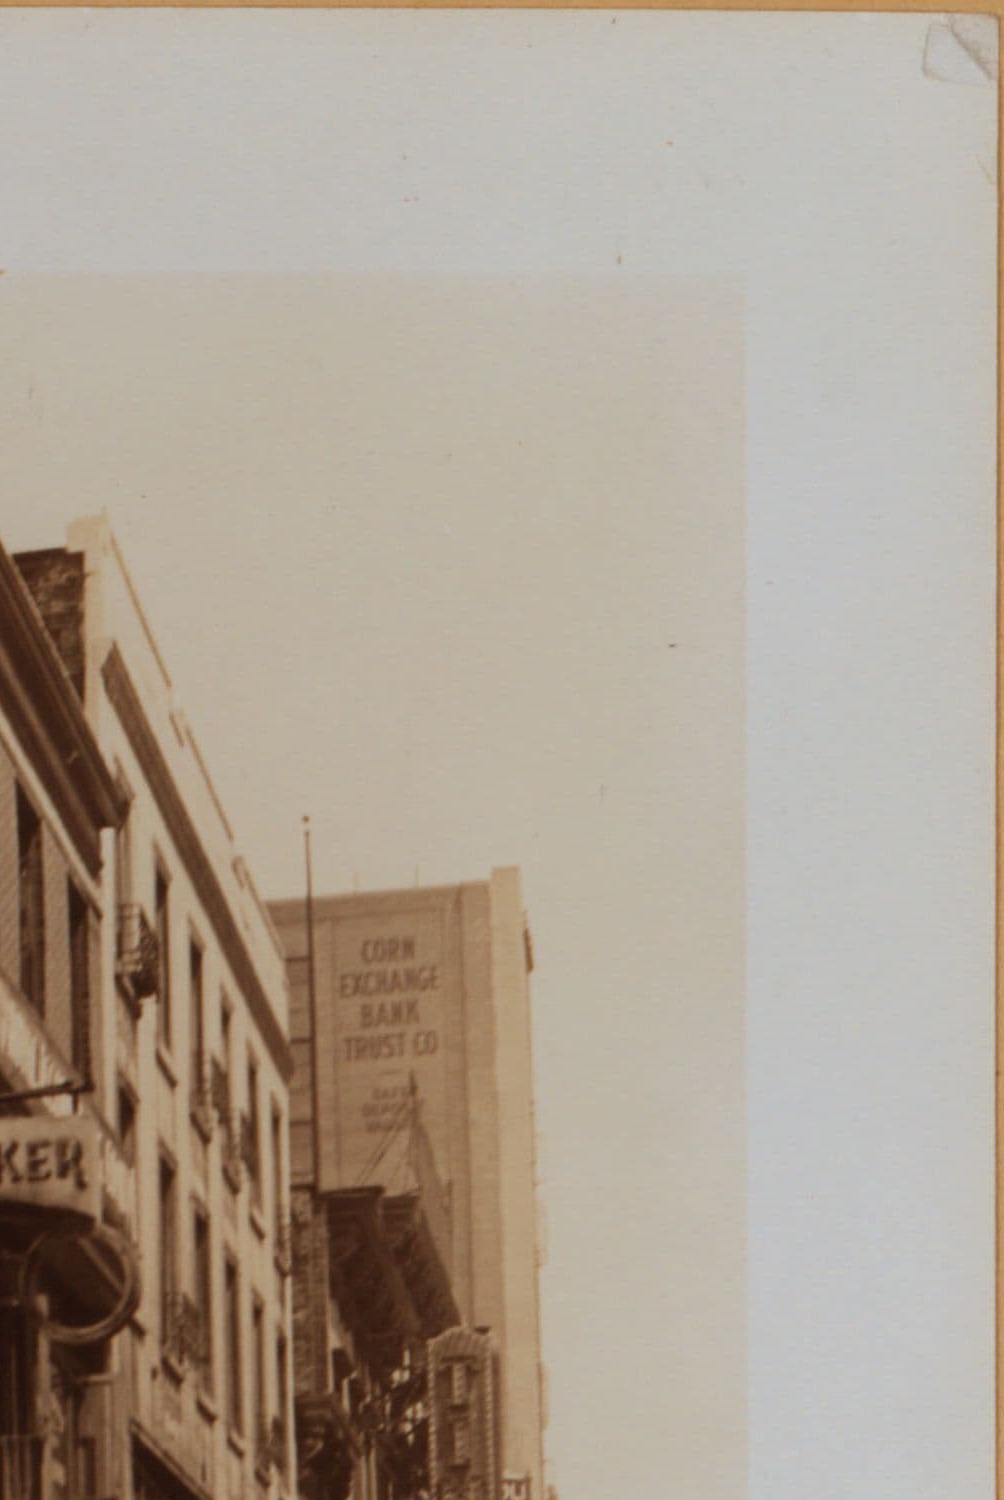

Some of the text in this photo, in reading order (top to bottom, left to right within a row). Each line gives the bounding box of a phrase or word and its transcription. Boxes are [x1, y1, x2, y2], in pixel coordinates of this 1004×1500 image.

[360, 937, 415, 963] CORN
[339, 966, 441, 998] EXCHANGE
[360, 1000, 421, 1029] BANK
[344, 1032, 406, 1062] TRUST
